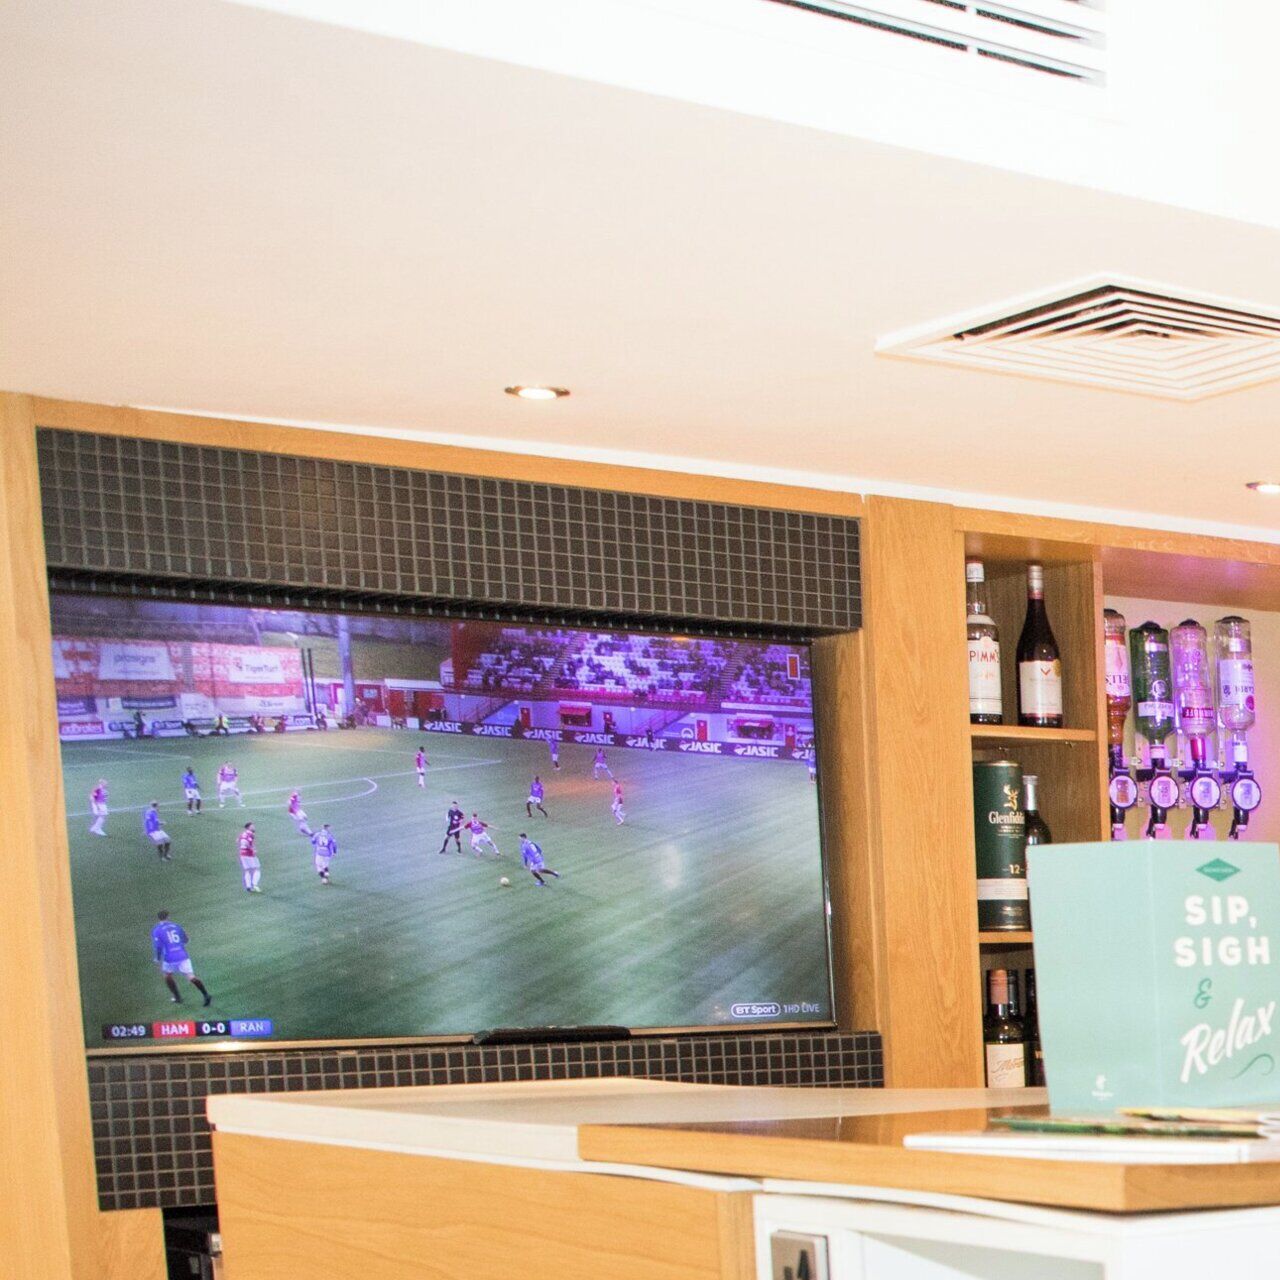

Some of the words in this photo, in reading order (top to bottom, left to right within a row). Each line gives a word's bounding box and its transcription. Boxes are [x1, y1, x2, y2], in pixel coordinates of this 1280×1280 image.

[433, 721, 462, 733] JASIC
[481, 725, 513, 737] JASIC
[582, 732, 615, 745] JASIC
[690, 741, 722, 753] JASIC
[744, 745, 779, 758] JASIC
[1009, 864, 1020, 874] 12
[1185, 896, 1257, 928] SIP,
[166, 930, 180, 944] 16
[1174, 936, 1271, 967] SIGH
[1193, 978, 1213, 1009] &
[751, 1005, 776, 1015] Sport
[111, 1025, 146, 1037] 02:49
[161, 1024, 189, 1035] HAM
[202, 1023, 225, 1034] 0-0
[239, 1021, 264, 1032] RAN
[1179, 998, 1276, 1083] Relax
